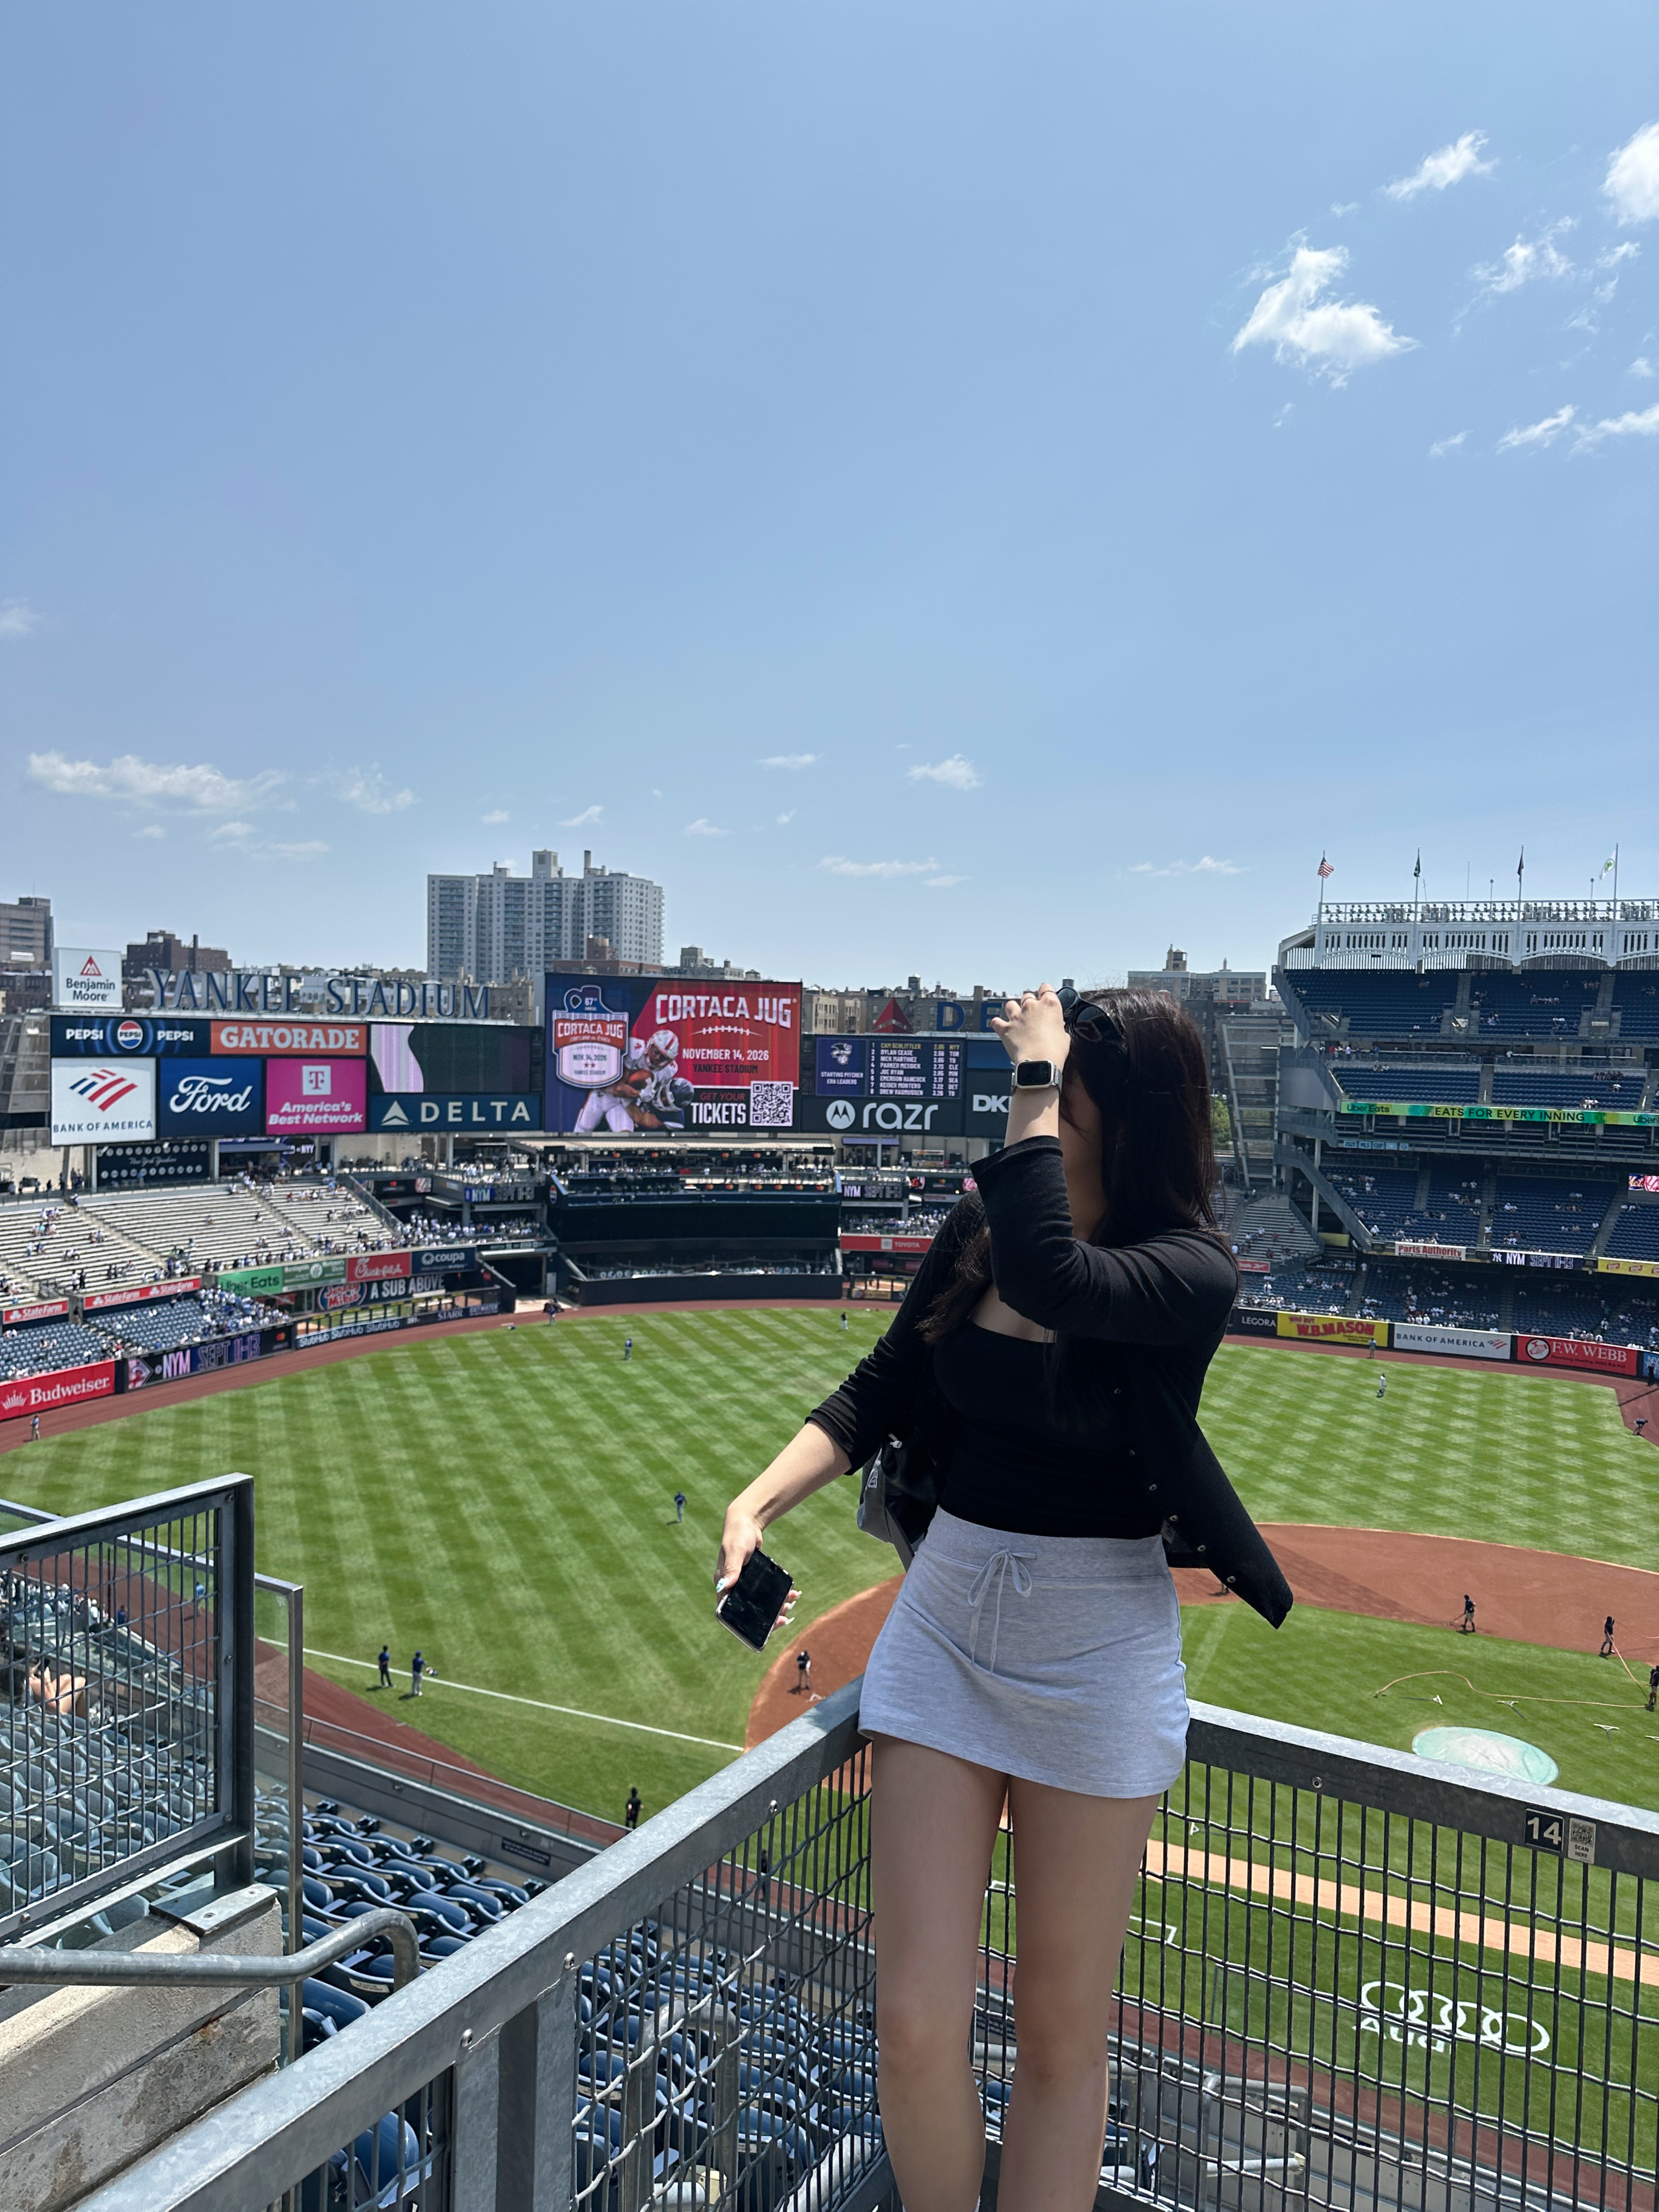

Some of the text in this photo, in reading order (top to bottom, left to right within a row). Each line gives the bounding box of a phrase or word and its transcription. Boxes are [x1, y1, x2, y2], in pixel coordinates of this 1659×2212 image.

[66, 978, 116, 991] Benjamin
[73, 990, 107, 1001] Moore
[144, 968, 492, 1019] YANKEE STADIUM
[656, 994, 792, 1029] CORTACA JUG
[66, 1028, 104, 1040] PEPSI
[157, 1030, 194, 1041] PEPSI
[221, 1026, 359, 1049] GATORADE
[557, 1022, 624, 1040] CORTACA JUG
[682, 1048, 769, 1062] NOVEMBER 14, 2026
[693, 1064, 758, 1074] YANKEE STADIUM
[309, 1071, 325, 1090] T
[169, 1075, 253, 1113] Ford
[700, 1092, 746, 1101] GET YOUR
[280, 1101, 352, 1113] America's
[421, 1101, 531, 1123] DELTA
[690, 1102, 747, 1125] TICKETS
[1347, 1104, 1390, 1113] Uber Eats
[269, 1112, 363, 1125] Best Network
[863, 1103, 939, 1131] razr
[1435, 1107, 1585, 1122] EATS FOR EVERY INNING
[1633, 1115, 1656, 1124] Uber
[53, 1120, 153, 1133] BANK OF AMERICA
[472, 1188, 490, 1201] NYM
[844, 1186, 861, 1198] NYM
[864, 1186, 884, 1198] SEPT
[435, 1252, 465, 1263] coupa
[1422, 1246, 1462, 1257] Authority
[1506, 1253, 1525, 1265] NYM
[1530, 1255, 1553, 1268] SEPT
[251, 1276, 280, 1289] Eats
[370, 1274, 445, 1300] A SUB ABOVE
[437, 1310, 464, 1321] STARR
[1242, 1316, 1277, 1327] LEGORA
[331, 1326, 364, 1340] StubHub
[366, 1321, 400, 1333] StubHub
[299, 1333, 329, 1347] StubHub
[1396, 1333, 1485, 1348] BANK OF AMERICA
[1552, 1341, 1578, 1356] F.W.
[1583, 1345, 1627, 1362] WEBB
[163, 1349, 191, 1379] NYM
[198, 1340, 232, 1372] SEPT
[30, 1376, 110, 1406] Budweiser
[1527, 1816, 1562, 1845] 14
